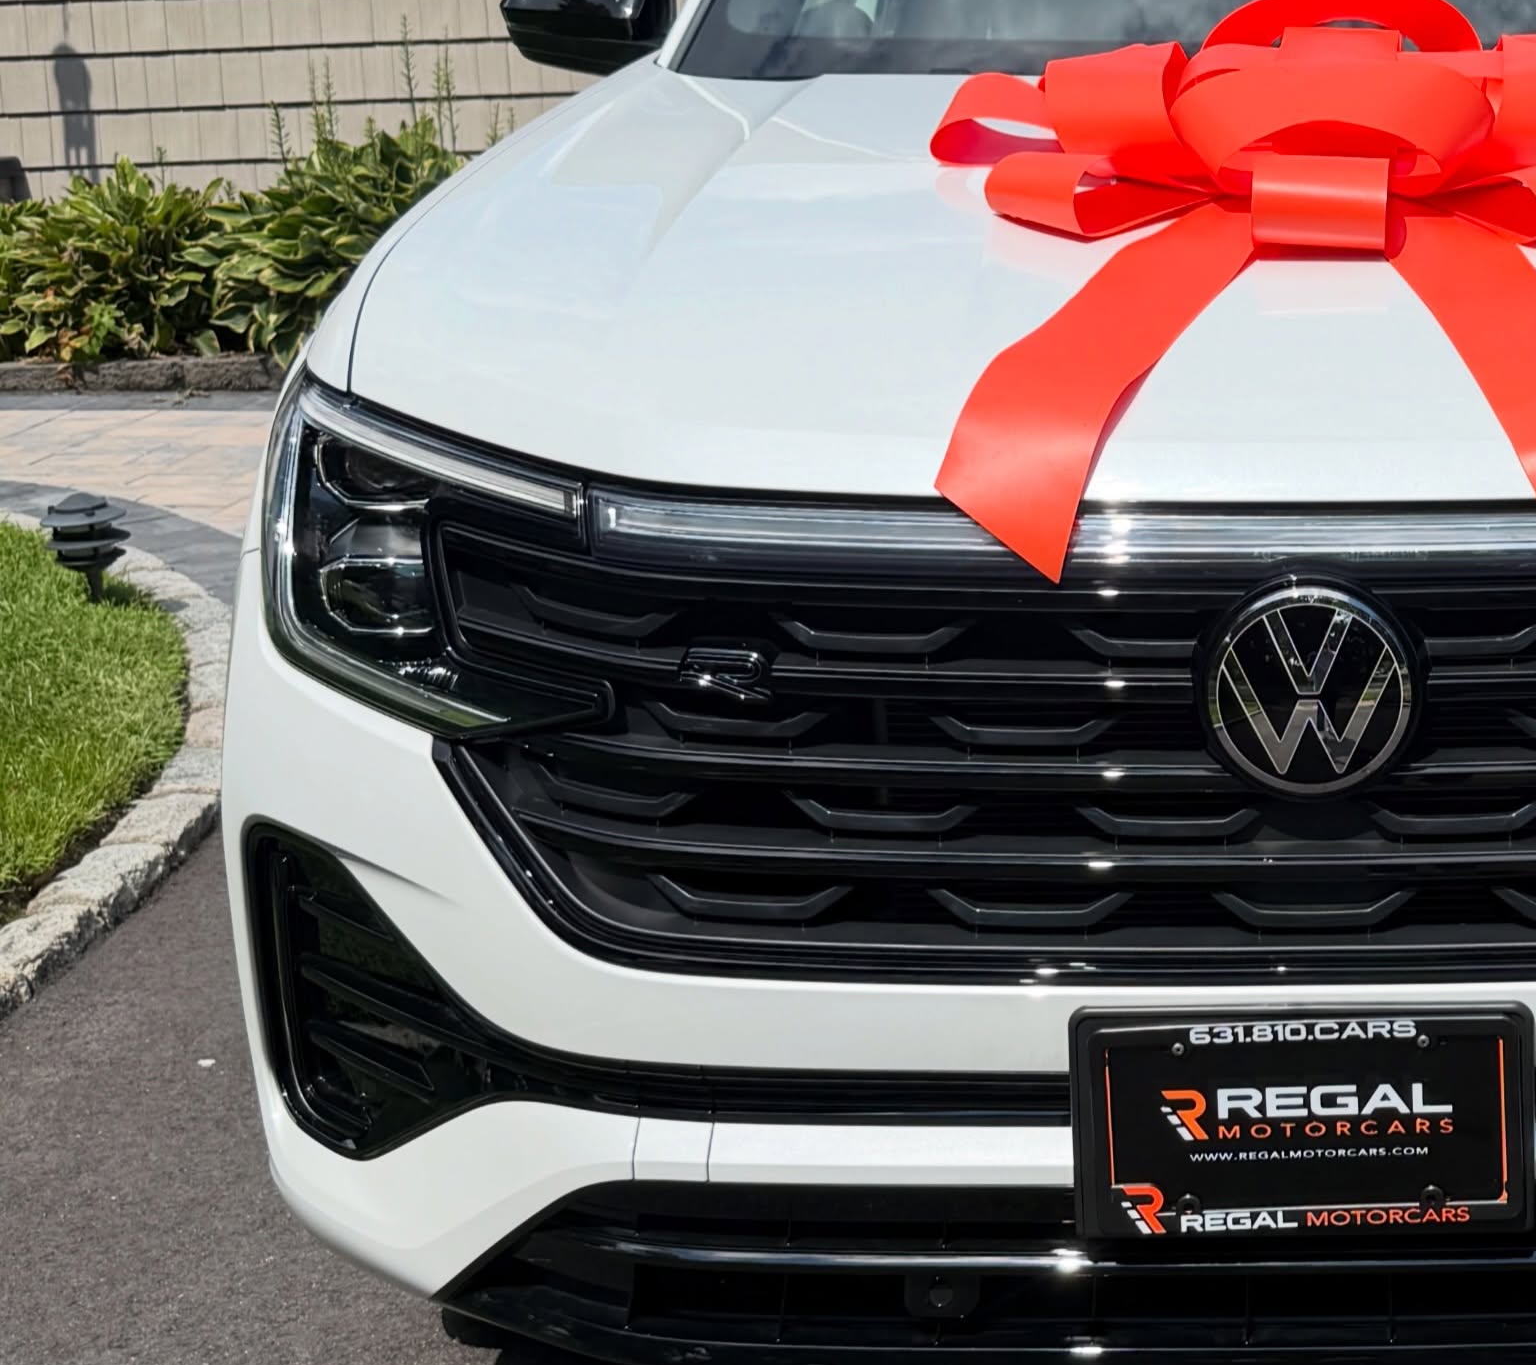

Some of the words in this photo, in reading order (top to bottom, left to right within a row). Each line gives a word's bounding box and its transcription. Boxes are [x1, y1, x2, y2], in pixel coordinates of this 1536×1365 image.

[1220, 607, 1399, 776] VW
[1188, 1019, 1417, 1045] 631.810.CARS
[1216, 1082, 1453, 1119] REGAL
[1218, 1117, 1454, 1140] MOTORCARS
[1189, 1146, 1430, 1163] WWW.REGALMOTORCARS.COM
[1180, 1209, 1299, 1233] REGAL
[1305, 1205, 1471, 1228] MOTORCARS
